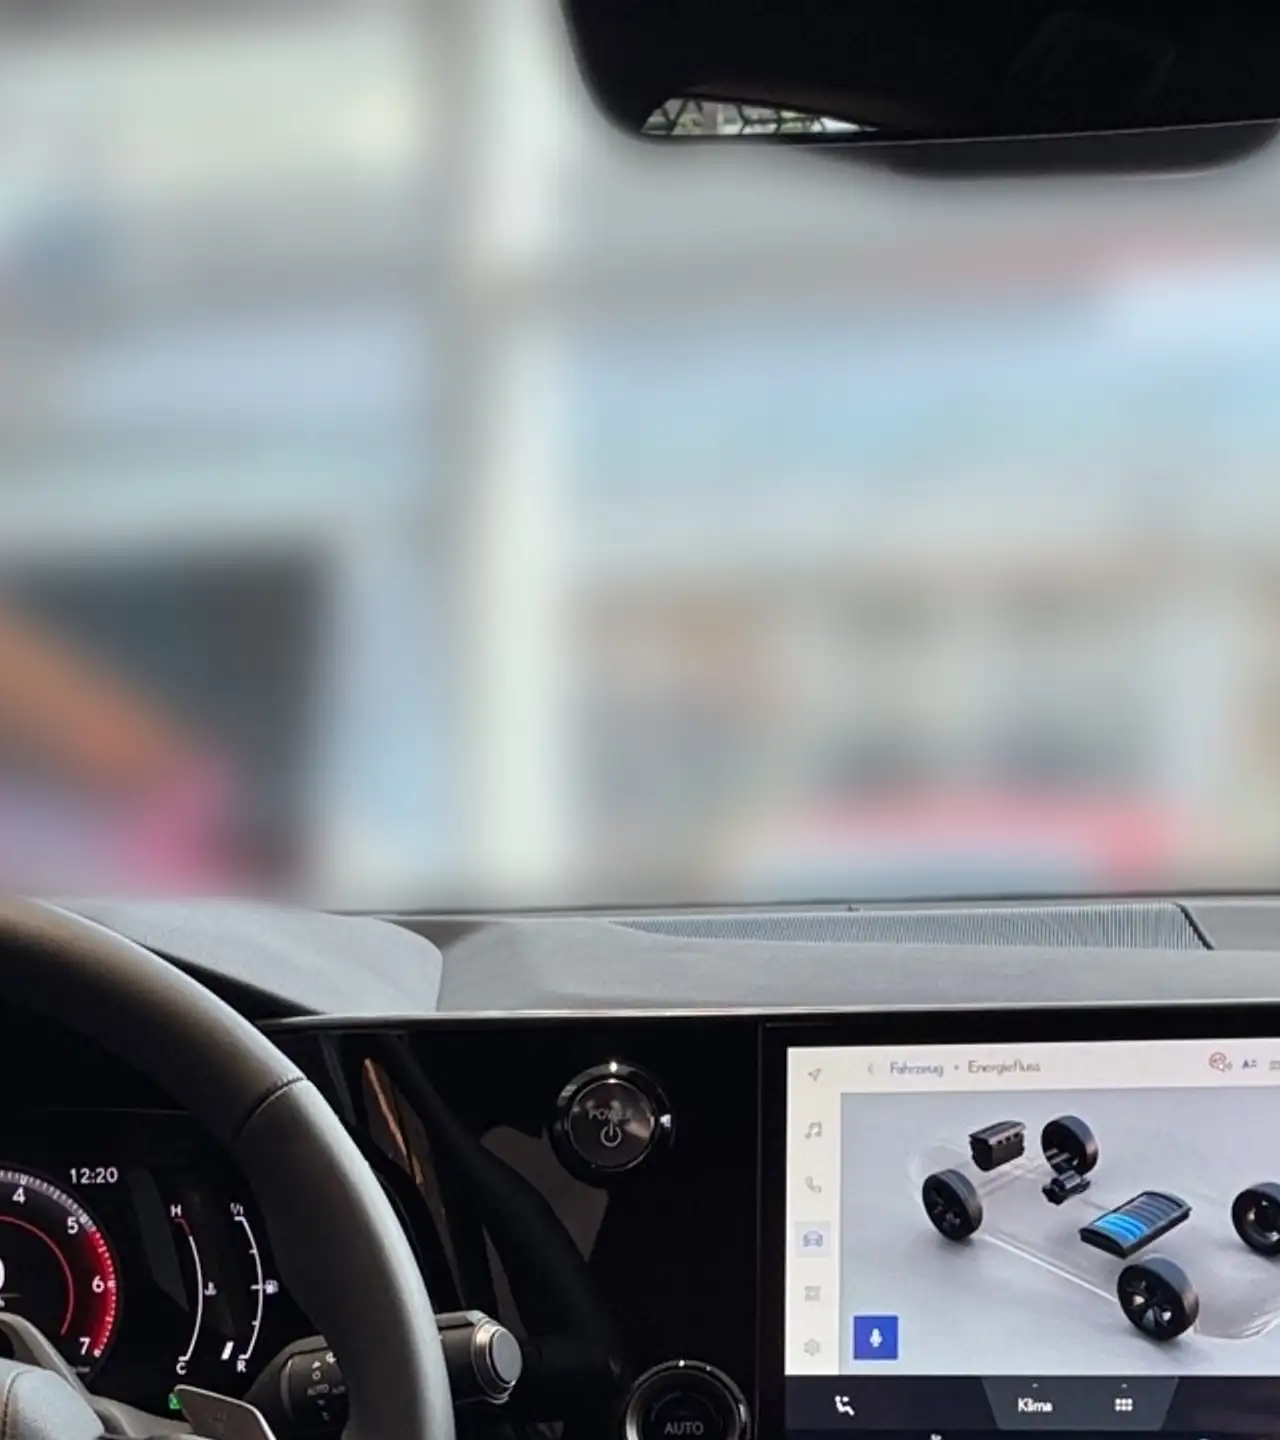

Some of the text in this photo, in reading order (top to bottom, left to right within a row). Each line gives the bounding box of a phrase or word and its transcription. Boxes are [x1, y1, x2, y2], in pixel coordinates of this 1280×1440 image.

[889, 1060, 944, 1078] Fahrzeug
[69, 1167, 119, 1185] 12:20
[11, 1186, 26, 1205] 4
[170, 1203, 182, 1217] H
[66, 1215, 80, 1235] 5
[91, 1275, 105, 1294] 6
[78, 1336, 91, 1356] 7
[175, 1361, 188, 1376] C
[235, 1360, 248, 1374] R
[1017, 1396, 1053, 1414] Klima
[663, 1420, 704, 1436] AUTO
